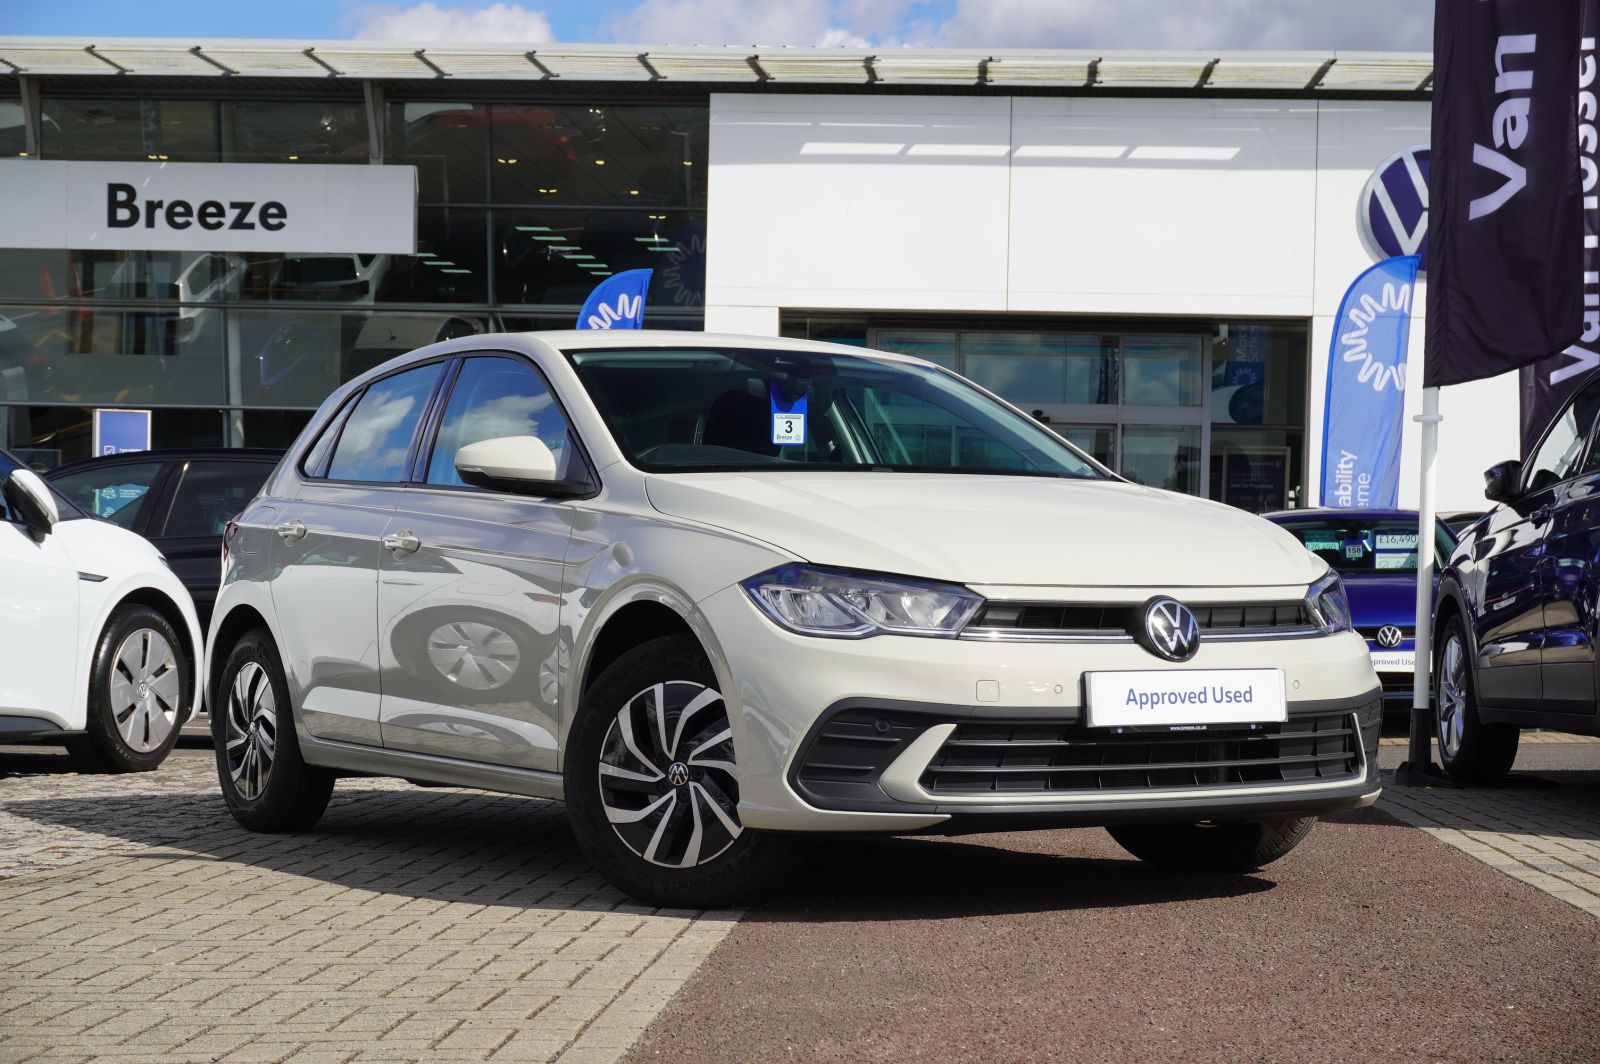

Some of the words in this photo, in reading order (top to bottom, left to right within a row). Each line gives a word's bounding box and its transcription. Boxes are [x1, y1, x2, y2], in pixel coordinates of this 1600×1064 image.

[1469, 34, 1537, 221] Van
[107, 182, 288, 231] Breeze
[785, 420, 793, 434] 3
[1126, 686, 1207, 710] Approved
[1212, 686, 1253, 704] Used
